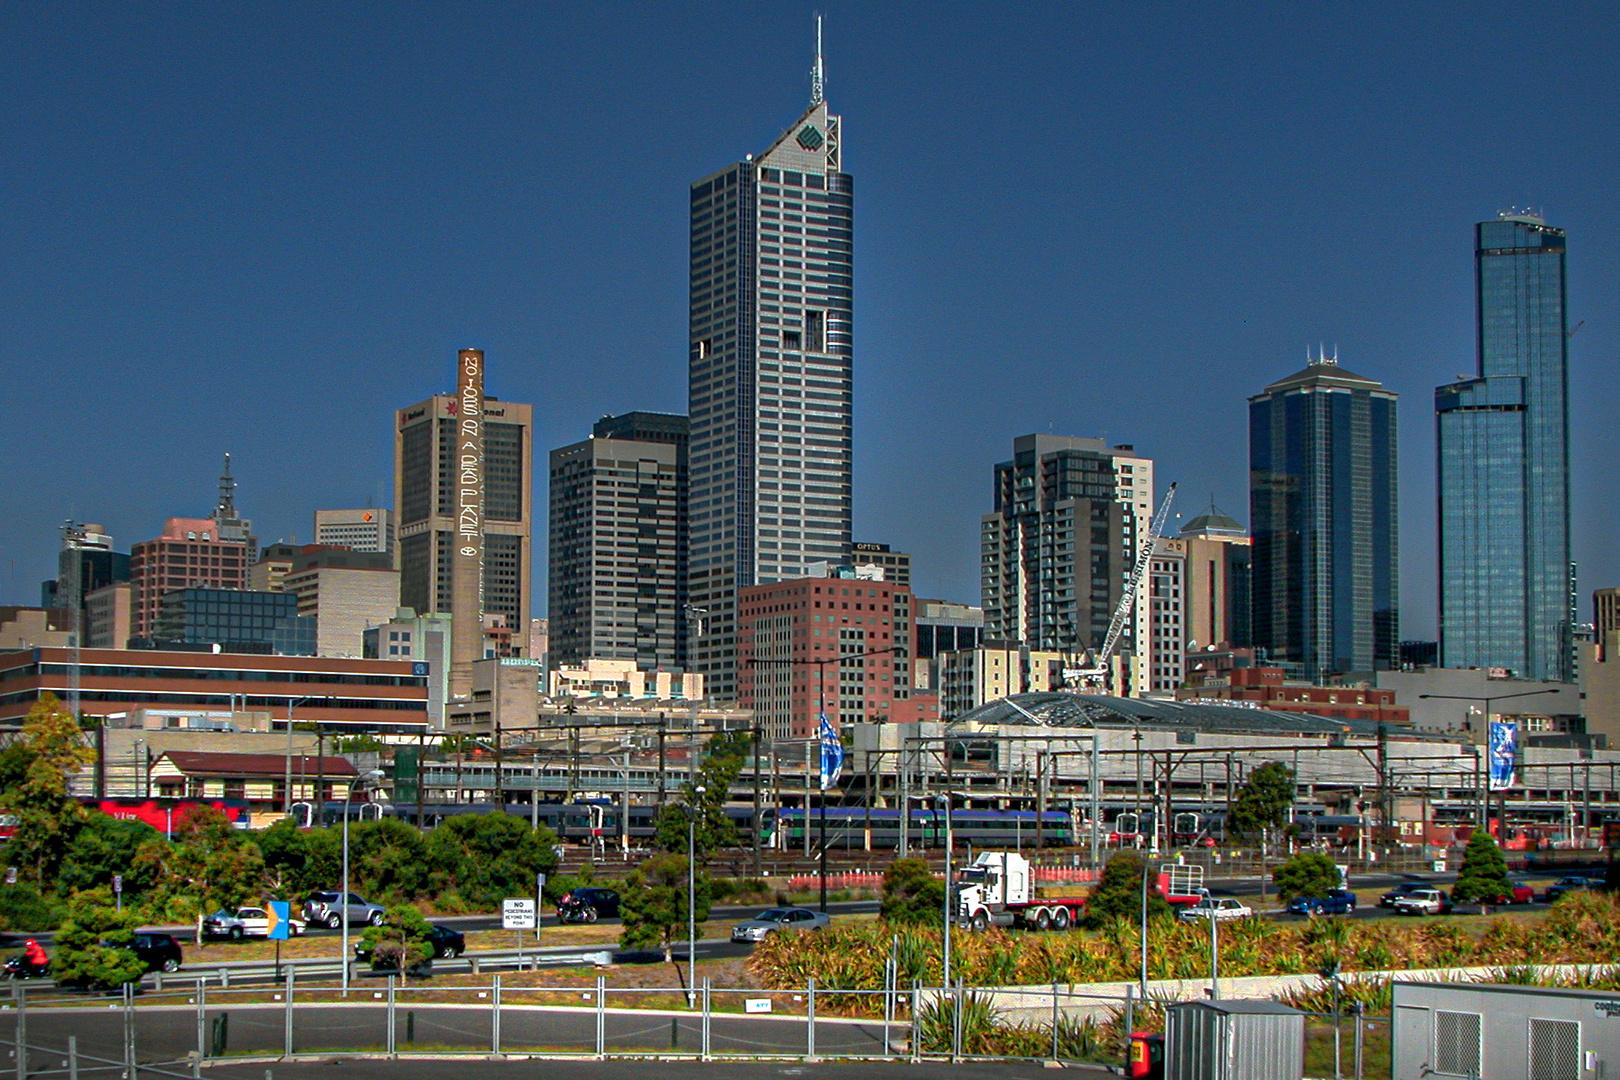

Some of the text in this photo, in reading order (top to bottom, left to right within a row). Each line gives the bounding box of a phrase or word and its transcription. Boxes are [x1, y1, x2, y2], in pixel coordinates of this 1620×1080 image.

[460, 356, 478, 542] NO JOBS ON A DEAD PLANET
[484, 409, 505, 417] onal
